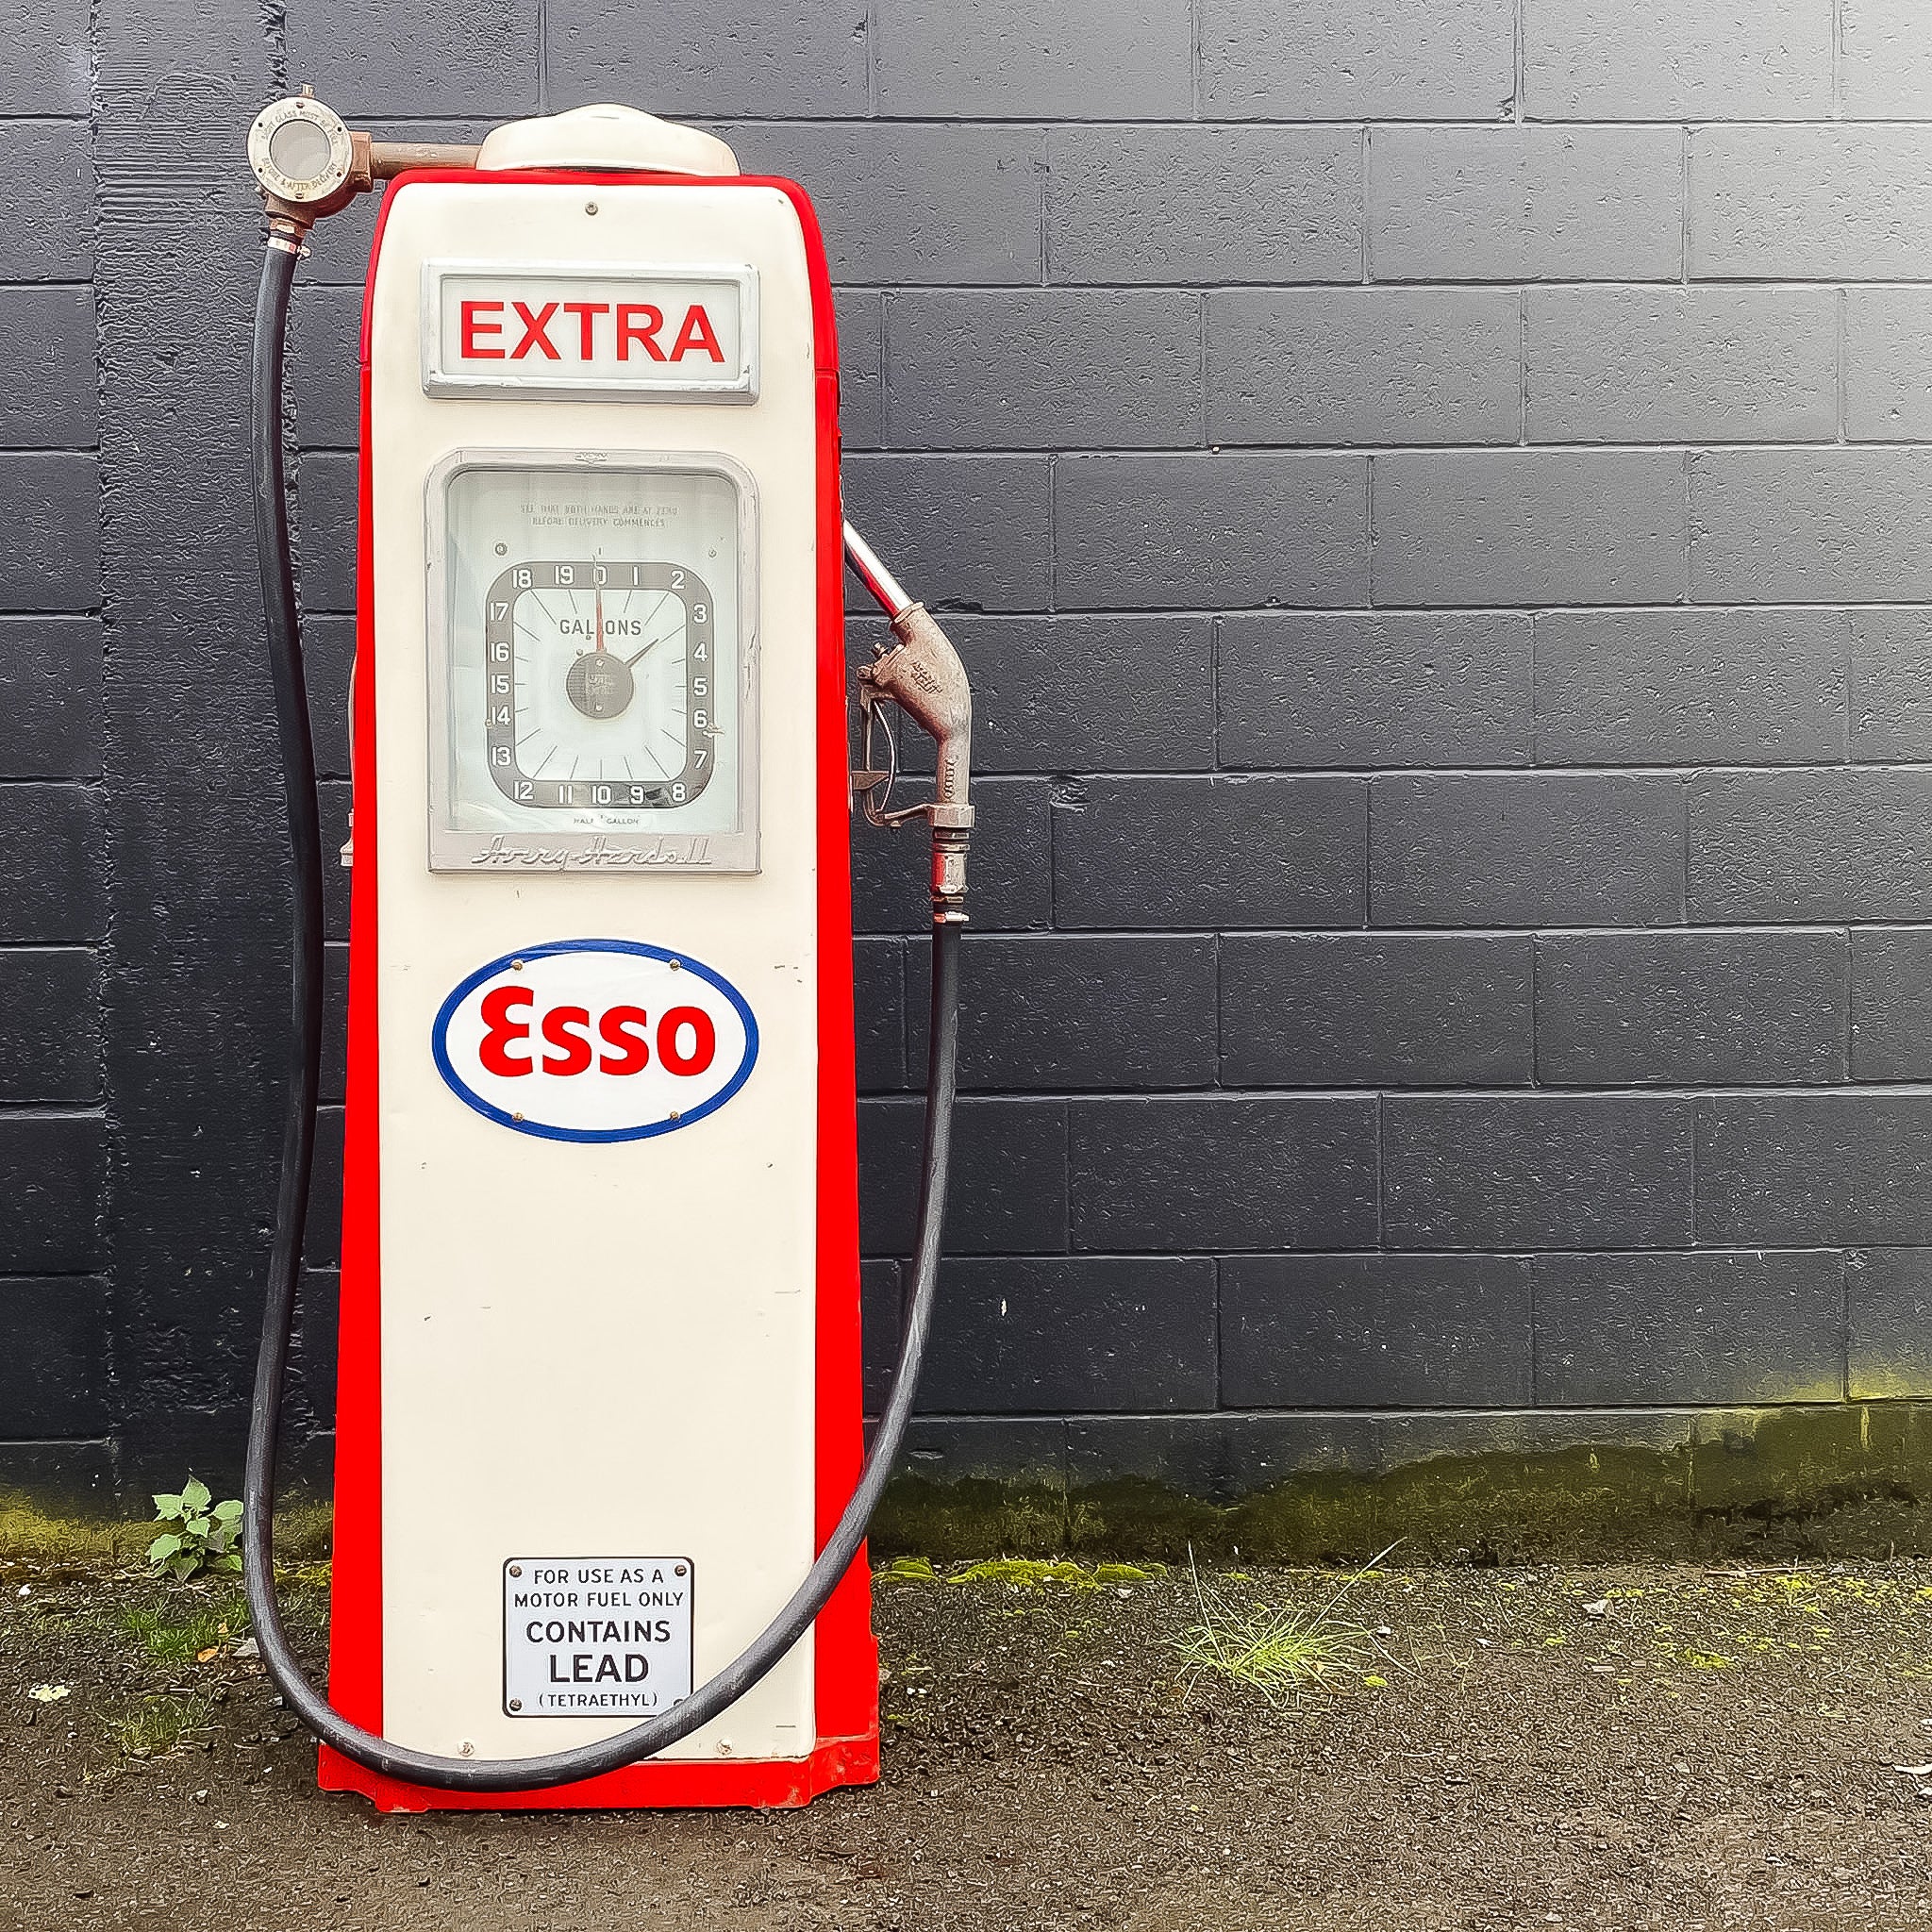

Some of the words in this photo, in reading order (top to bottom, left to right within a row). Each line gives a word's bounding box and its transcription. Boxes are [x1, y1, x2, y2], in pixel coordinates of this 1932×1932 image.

[287, 180, 311, 191] AFTER
[460, 300, 725, 363] EXTRA
[613, 517, 665, 526] COMMENCES
[512, 569, 533, 589] 18
[554, 565, 575, 585] 19
[632, 565, 639, 586] 1
[671, 570, 686, 590] 2
[490, 602, 509, 622] 17
[693, 605, 708, 623] 3
[559, 619, 641, 635] GALONS
[490, 641, 509, 661] 16
[693, 642, 708, 661] 4
[491, 675, 510, 694] 15
[693, 677, 708, 696] 5
[491, 706, 510, 725] 14
[693, 709, 708, 728] 6
[491, 746, 511, 766] 13
[693, 750, 708, 769] 7
[513, 780, 535, 800] 12
[558, 785, 573, 804] 11
[591, 785, 612, 804] 10
[630, 785, 644, 804] 9
[672, 782, 687, 802] 8
[479, 985, 716, 1077] Esso
[534, 1569, 569, 1584] FOR
[577, 1569, 613, 1583] USE
[620, 1569, 644, 1583] AS
[651, 1569, 664, 1583] A
[514, 1592, 578, 1607] MOTOR
[587, 1592, 632, 1607] FUEL
[639, 1591, 684, 1607] ONLY
[525, 1620, 671, 1643] CONTAINS
[549, 1654, 649, 1683] LEAD
[539, 1692, 658, 1707] (TETRAETHYL)
